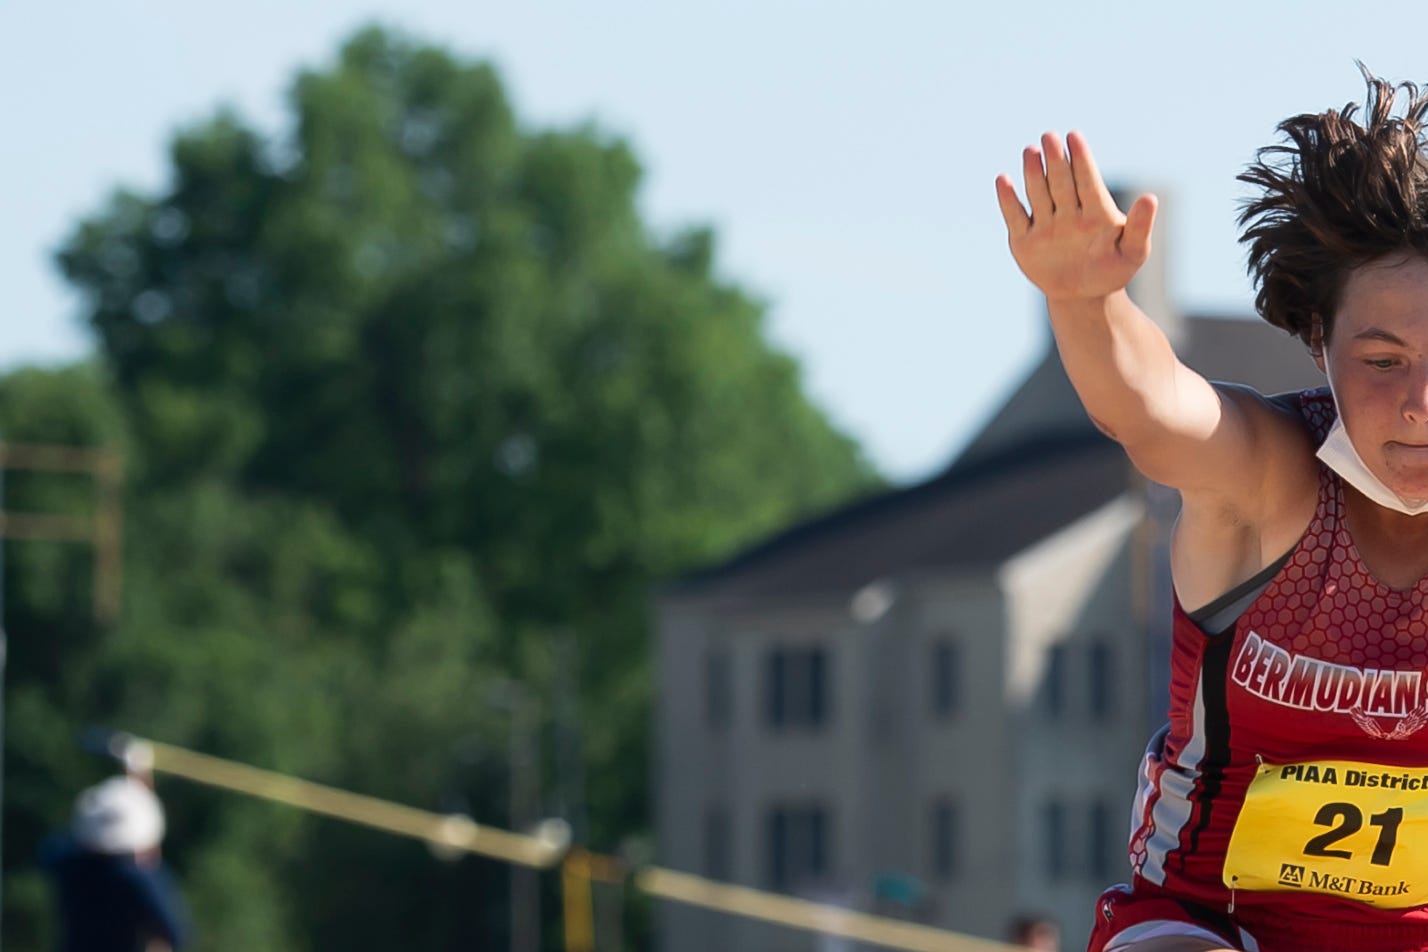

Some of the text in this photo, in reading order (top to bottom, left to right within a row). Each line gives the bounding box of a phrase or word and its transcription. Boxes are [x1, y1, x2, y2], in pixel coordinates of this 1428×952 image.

[1231, 630, 1423, 718] BERMUDIAN
[1280, 765, 1337, 785] PIAA
[1303, 802, 1404, 866] 21
[1308, 871, 1411, 896] M&T Bank
